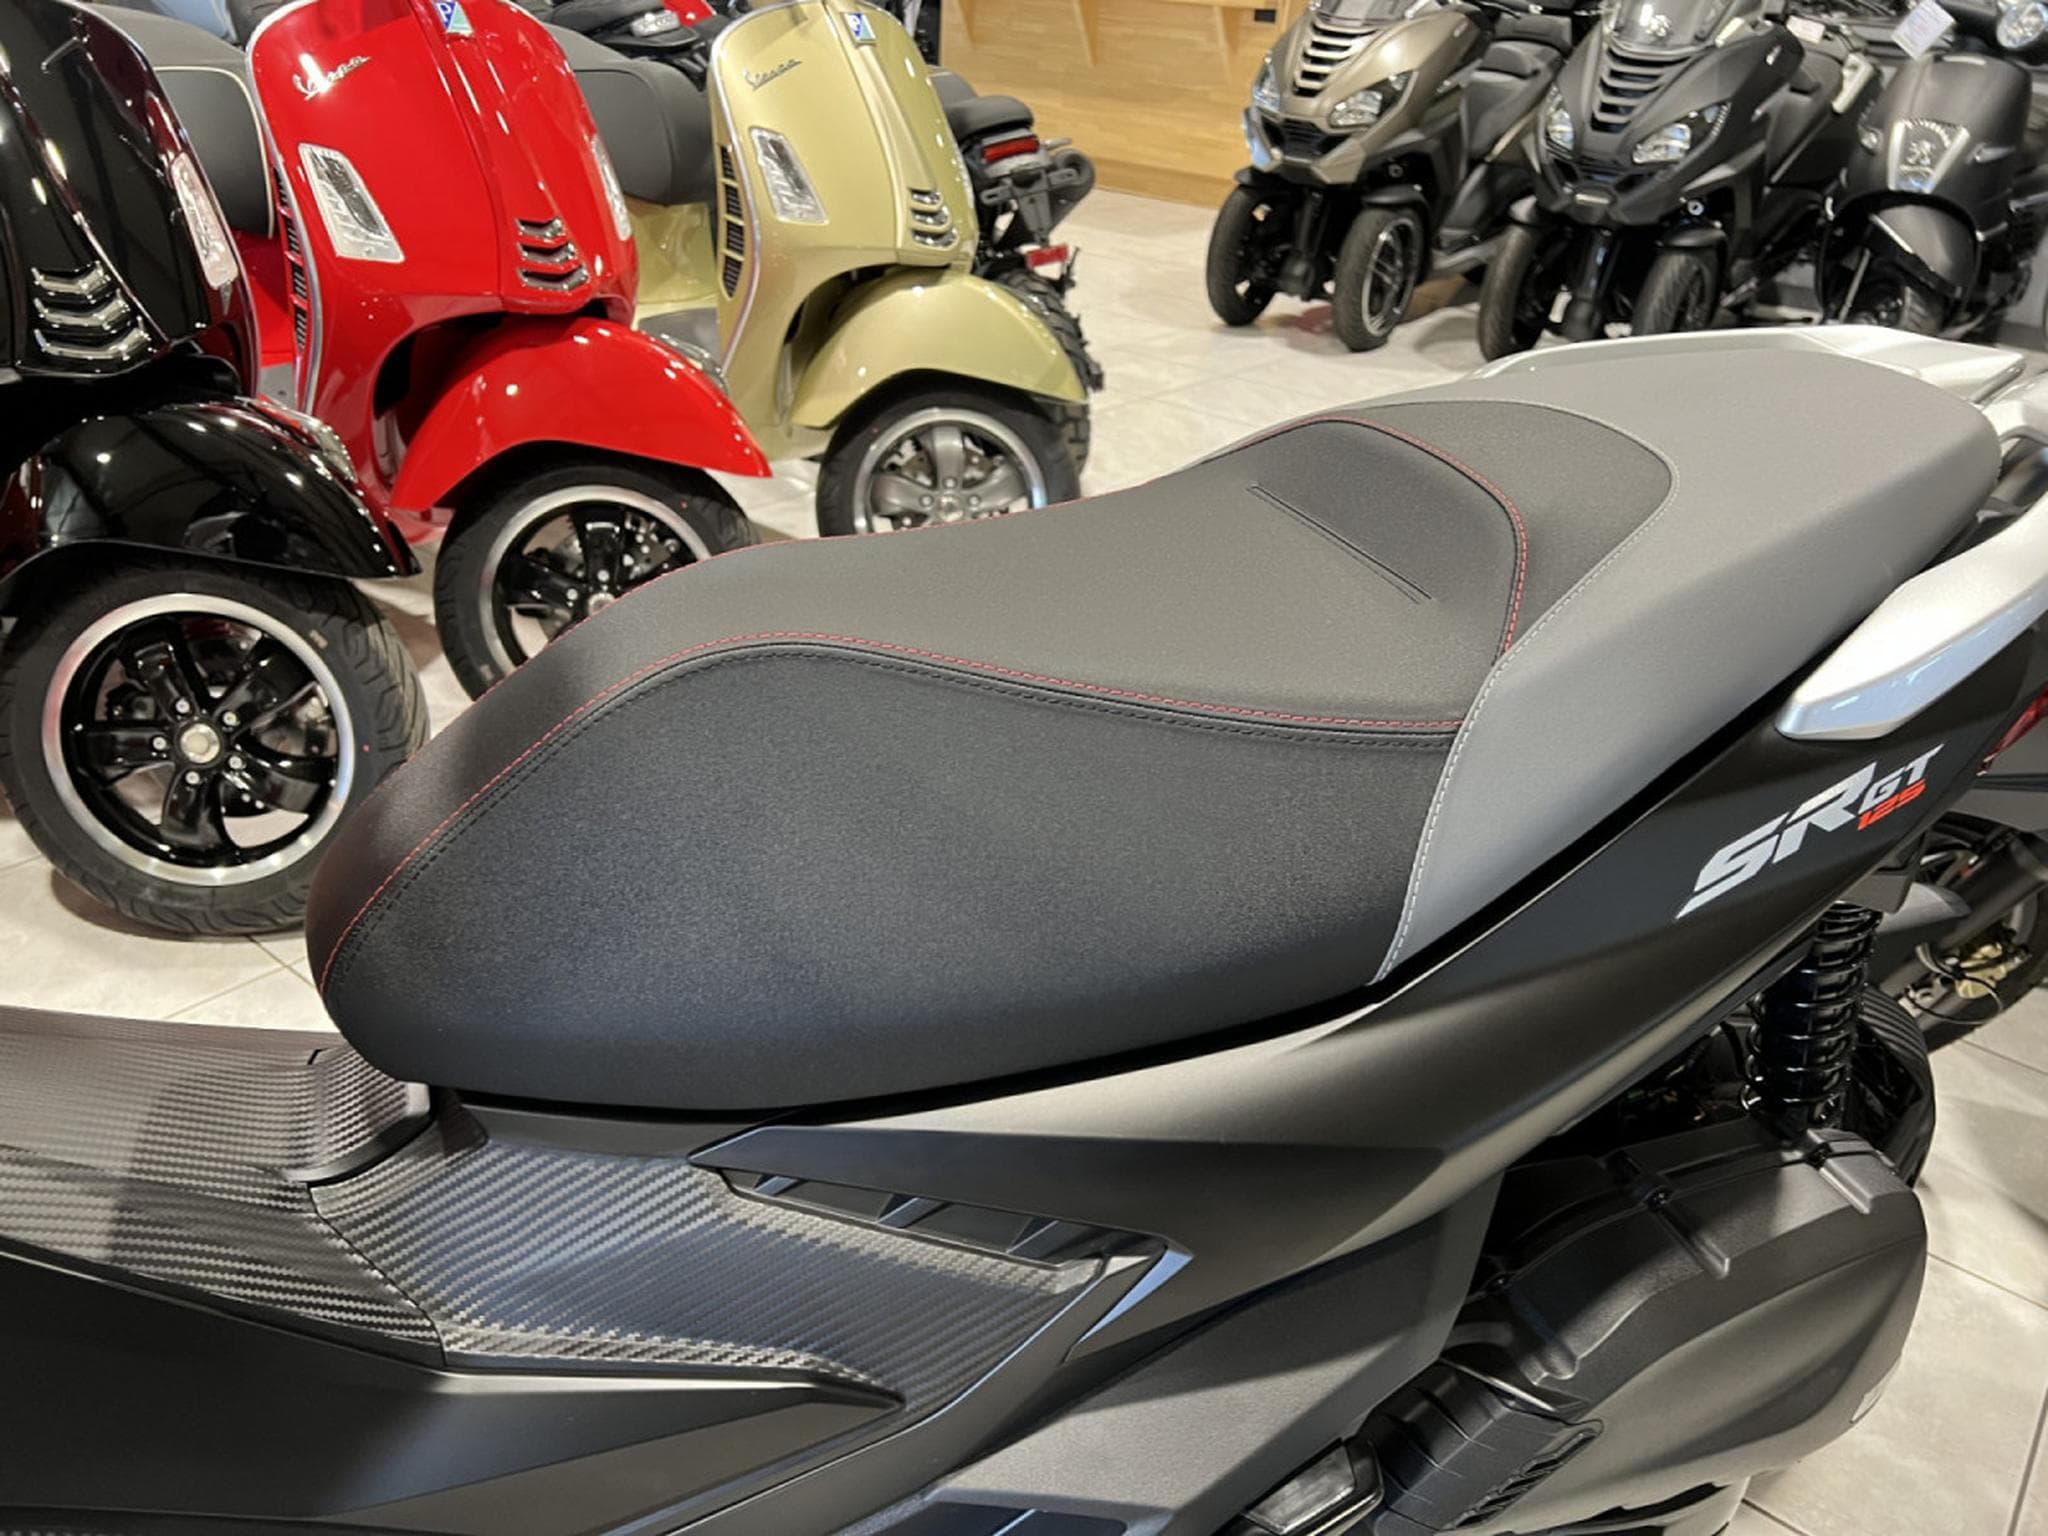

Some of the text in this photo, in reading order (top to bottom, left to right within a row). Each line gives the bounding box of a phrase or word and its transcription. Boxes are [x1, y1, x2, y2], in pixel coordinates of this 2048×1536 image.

[291, 54, 371, 101] Vspa
[1857, 778, 1926, 830] 125
[1675, 743, 1944, 919] SR GT
